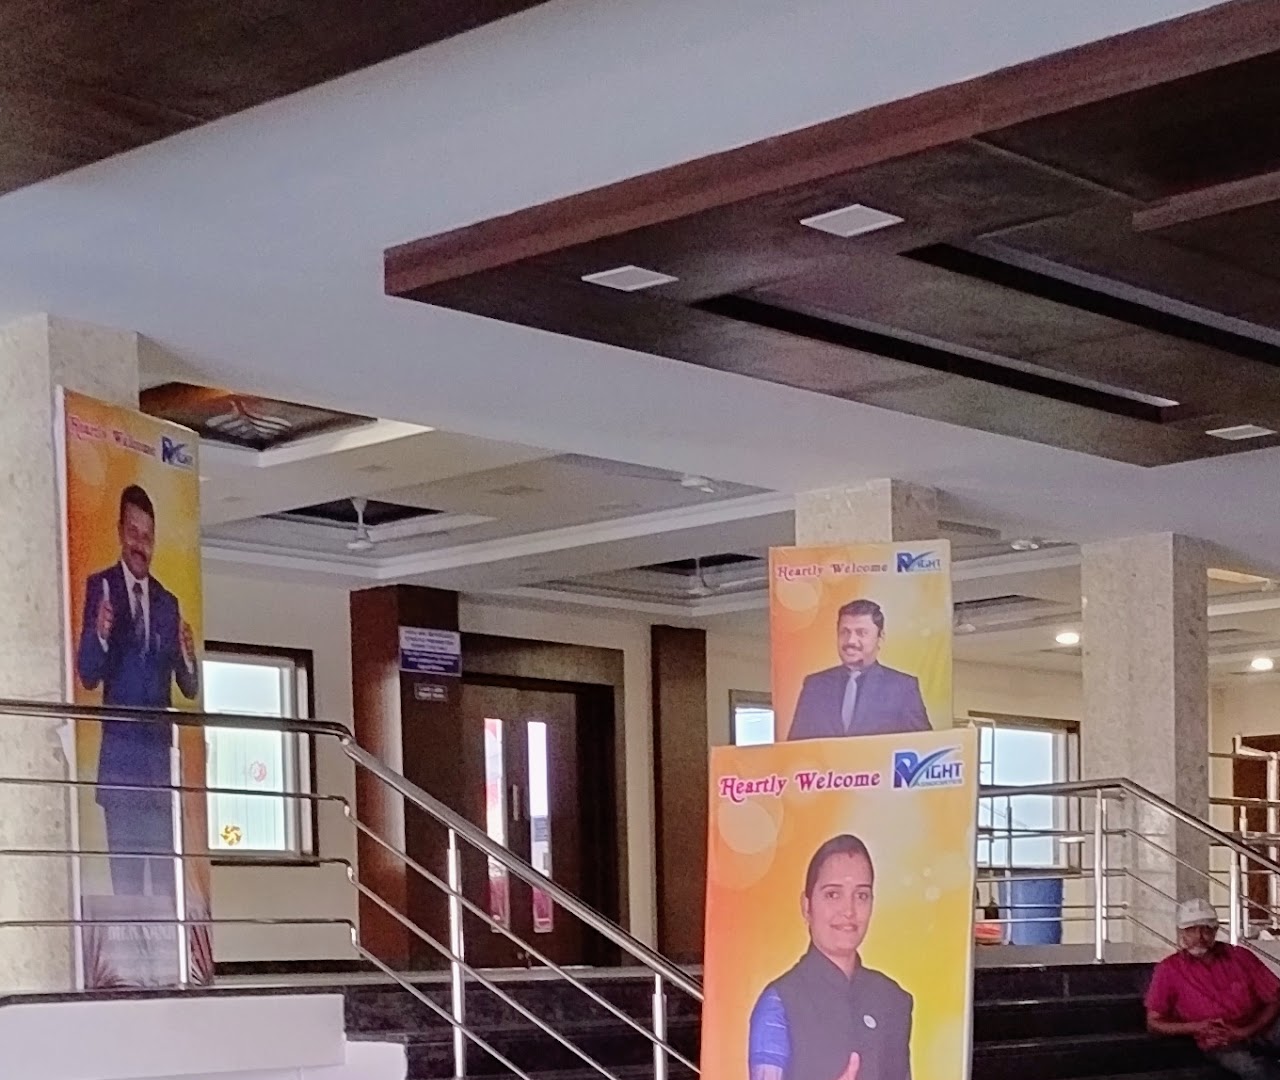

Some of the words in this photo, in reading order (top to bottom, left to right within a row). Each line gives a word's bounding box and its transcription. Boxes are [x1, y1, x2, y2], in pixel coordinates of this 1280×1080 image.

[777, 565, 823, 582] Heartly
[830, 563, 888, 575] Welcome
[720, 775, 787, 803] Heartly
[795, 771, 880, 791] Welcome
